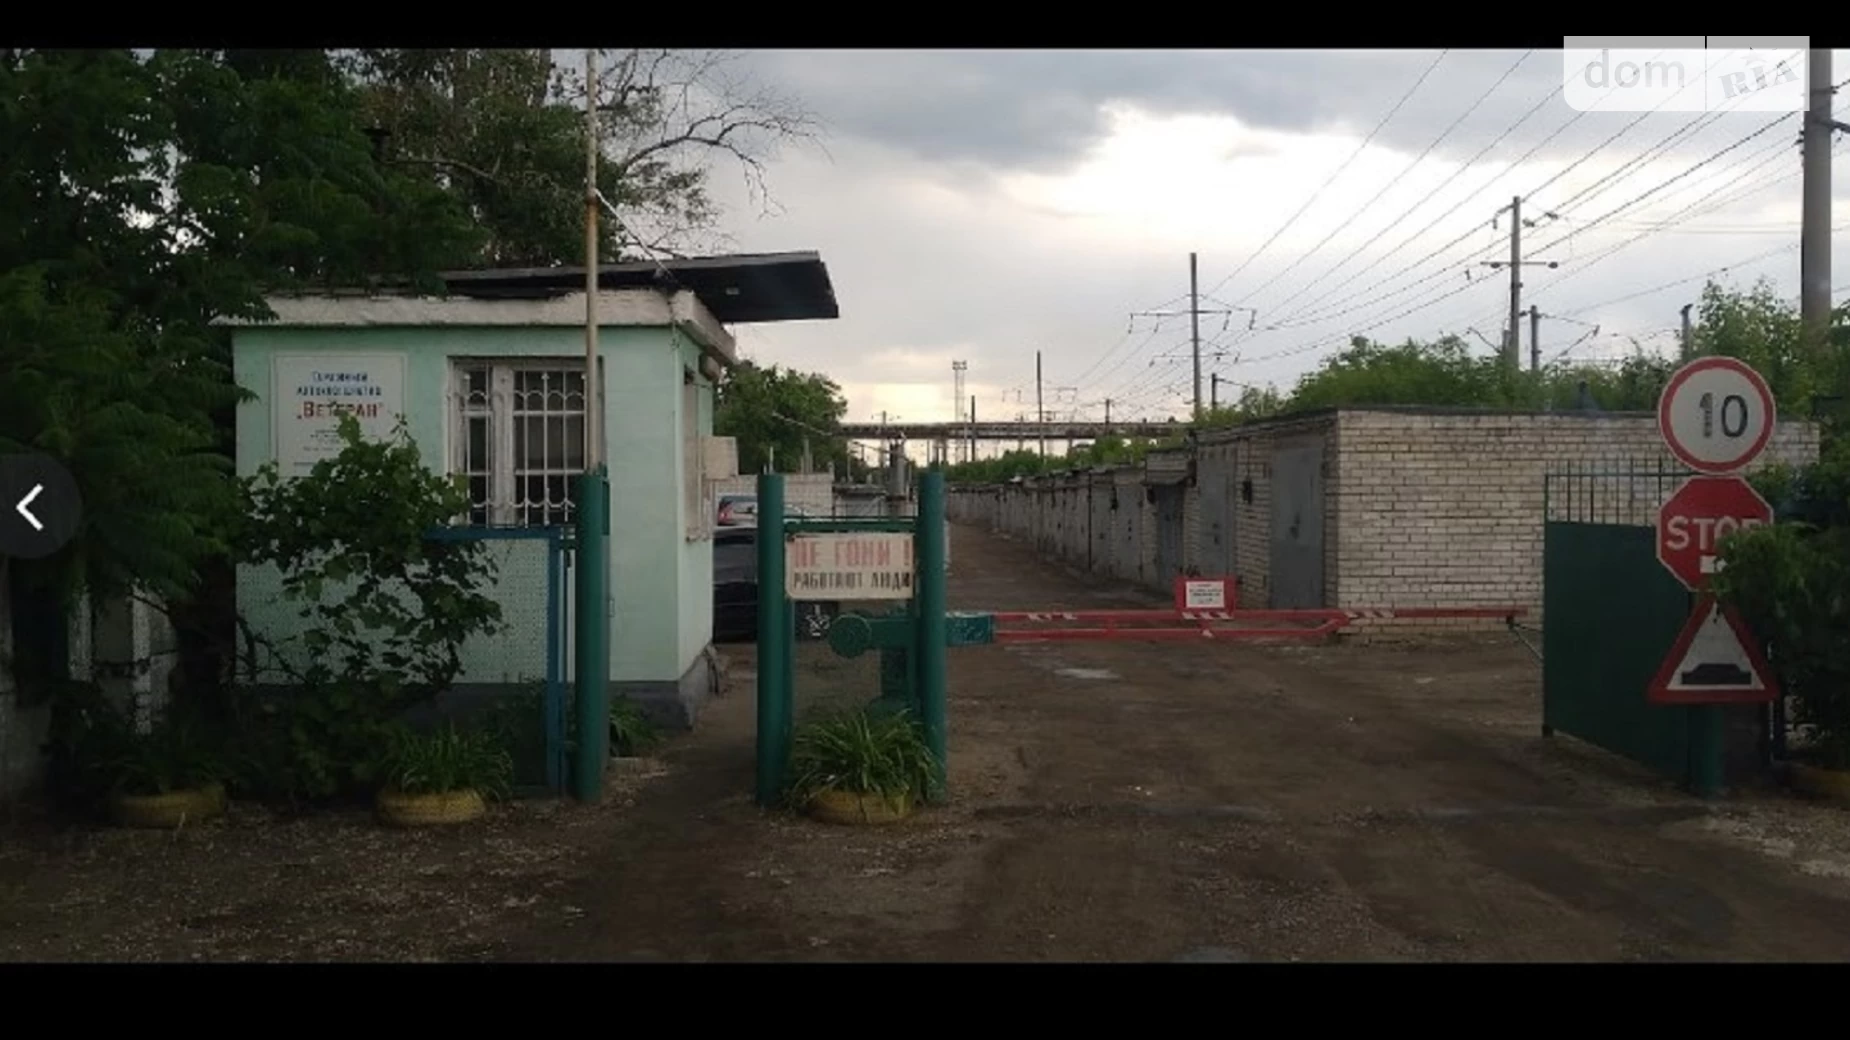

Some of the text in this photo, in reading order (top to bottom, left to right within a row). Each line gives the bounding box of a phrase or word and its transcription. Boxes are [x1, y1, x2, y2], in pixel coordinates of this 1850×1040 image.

[1699, 392, 1748, 438] 10
[1665, 515, 1764, 551] STO
[794, 541, 821, 568] НЕ
[835, 540, 890, 567] ГОНИ
[794, 571, 911, 592] РАБОТАЮТ ЛЮДИ
